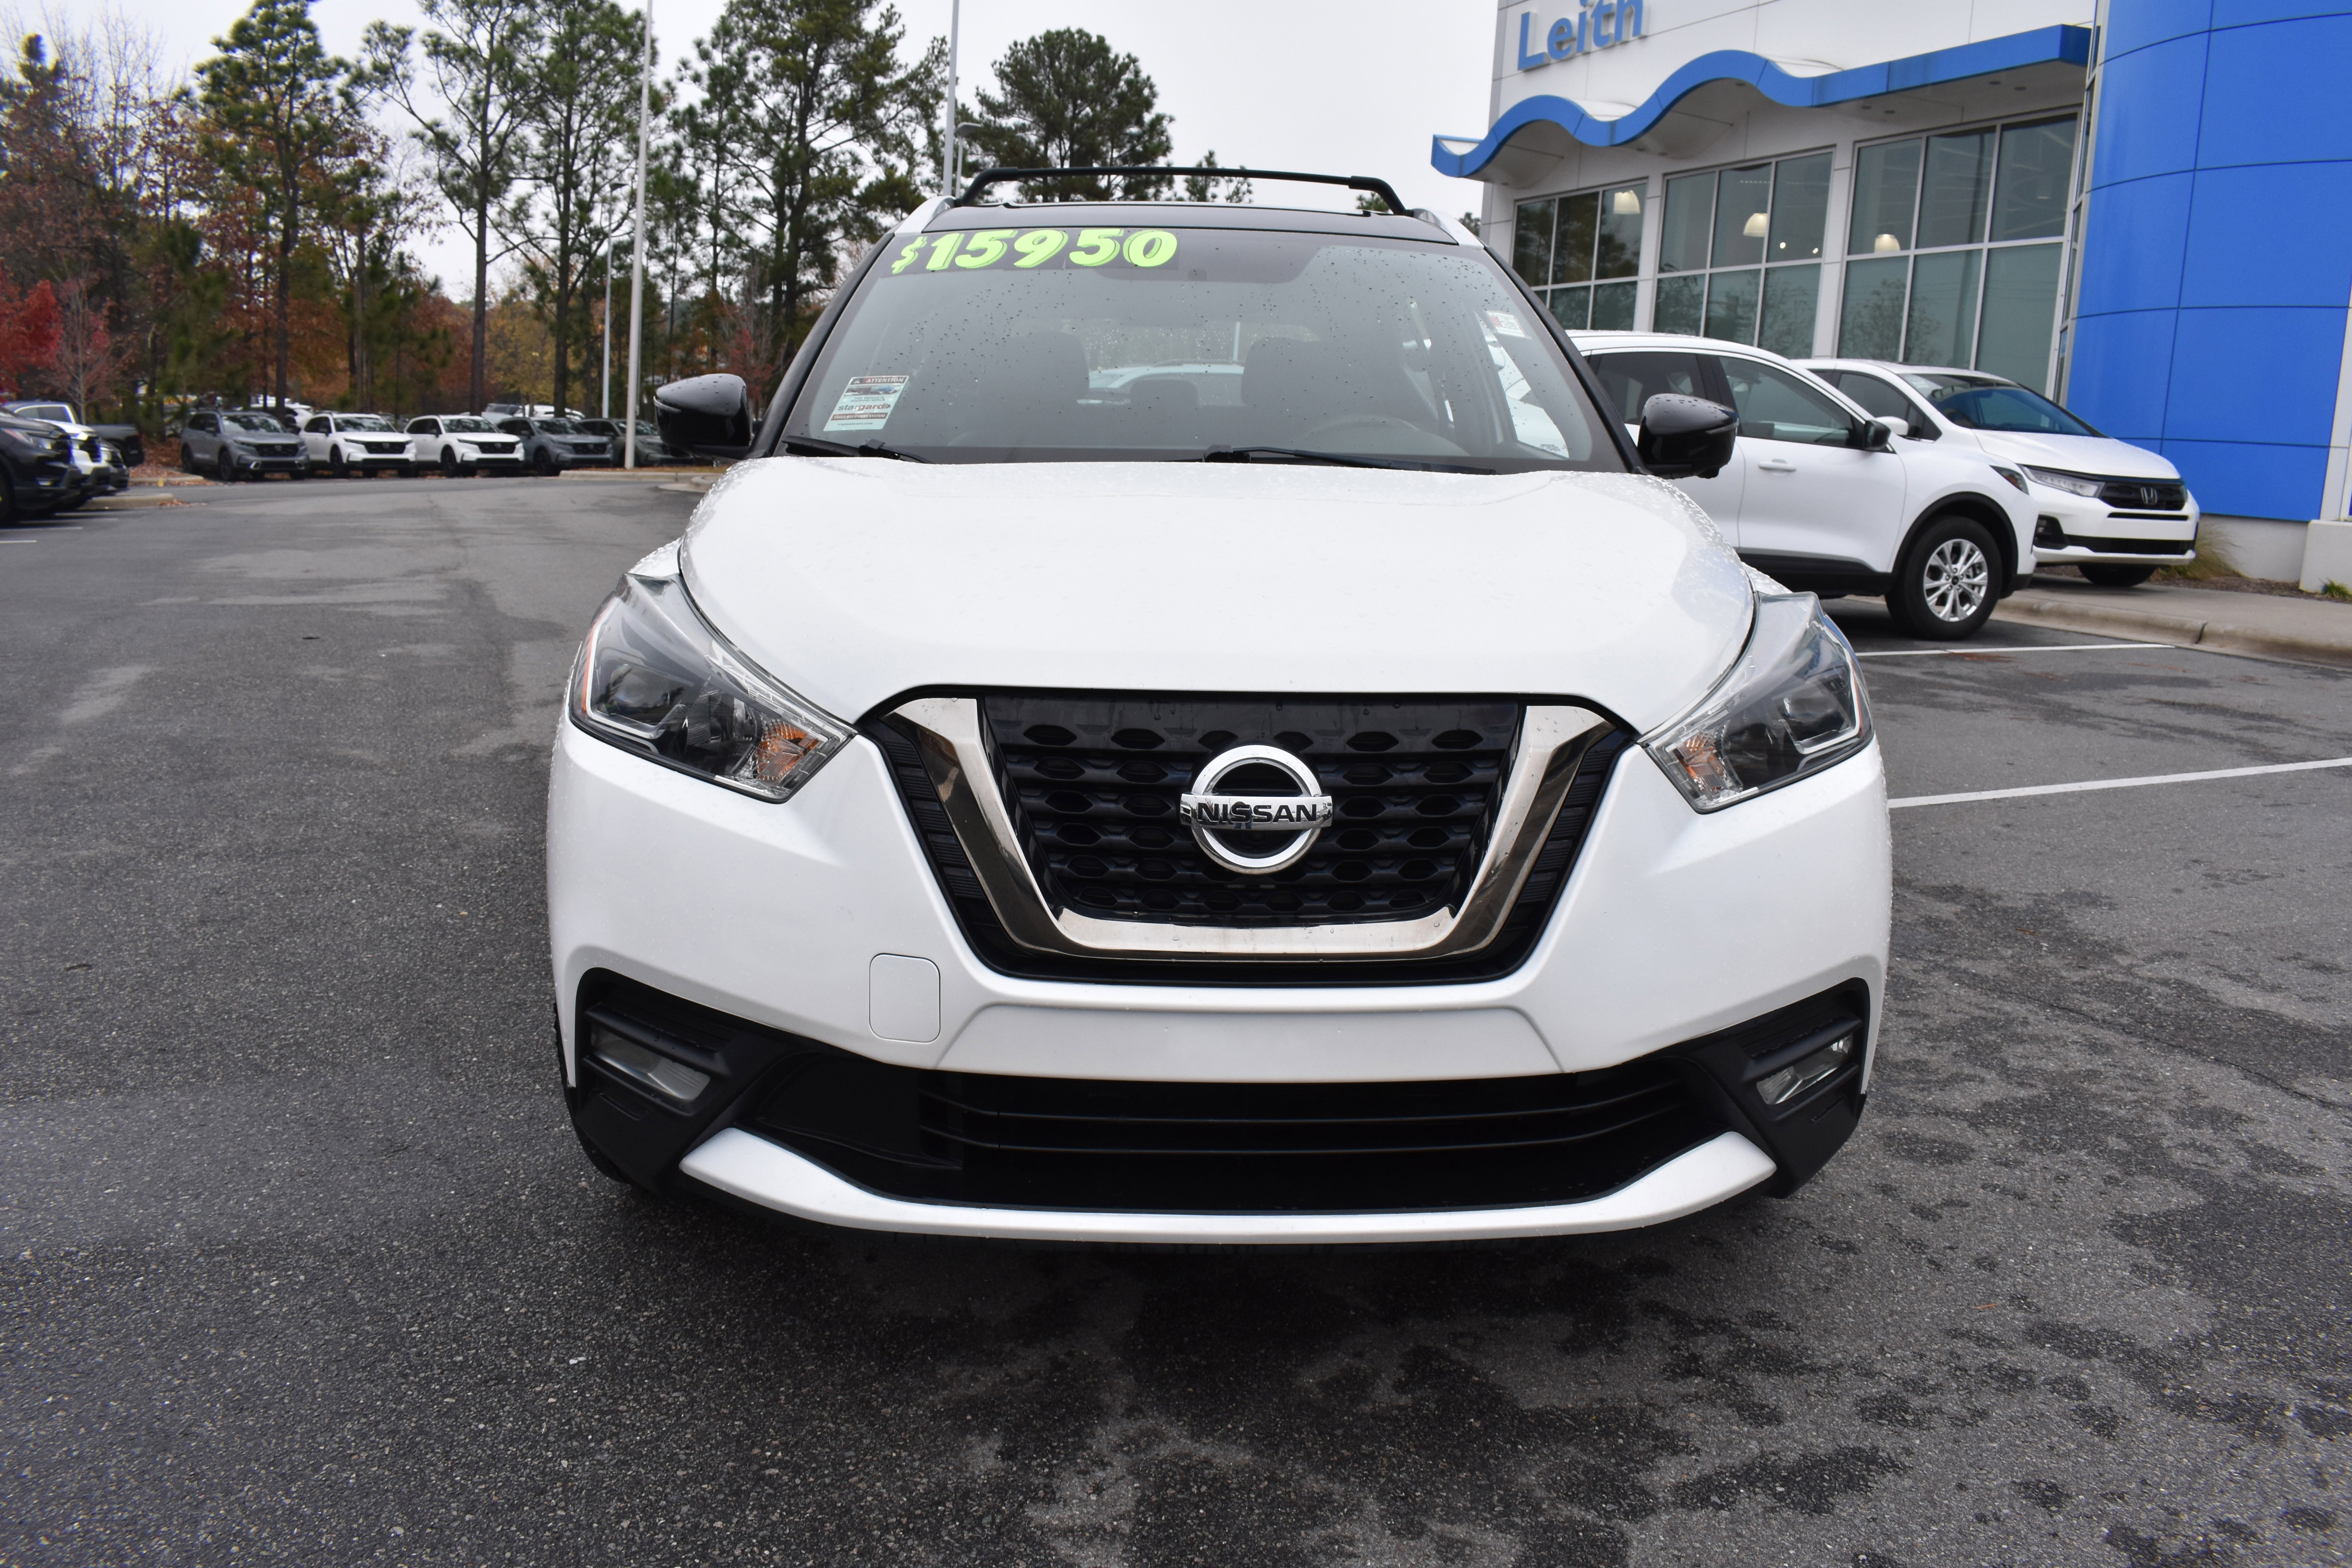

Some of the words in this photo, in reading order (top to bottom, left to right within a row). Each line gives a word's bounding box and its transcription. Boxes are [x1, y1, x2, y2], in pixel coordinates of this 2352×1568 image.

[1517, 0, 1645, 70] Leith
[891, 229, 1178, 274] $15950
[1197, 802, 1317, 823] NISSAN
